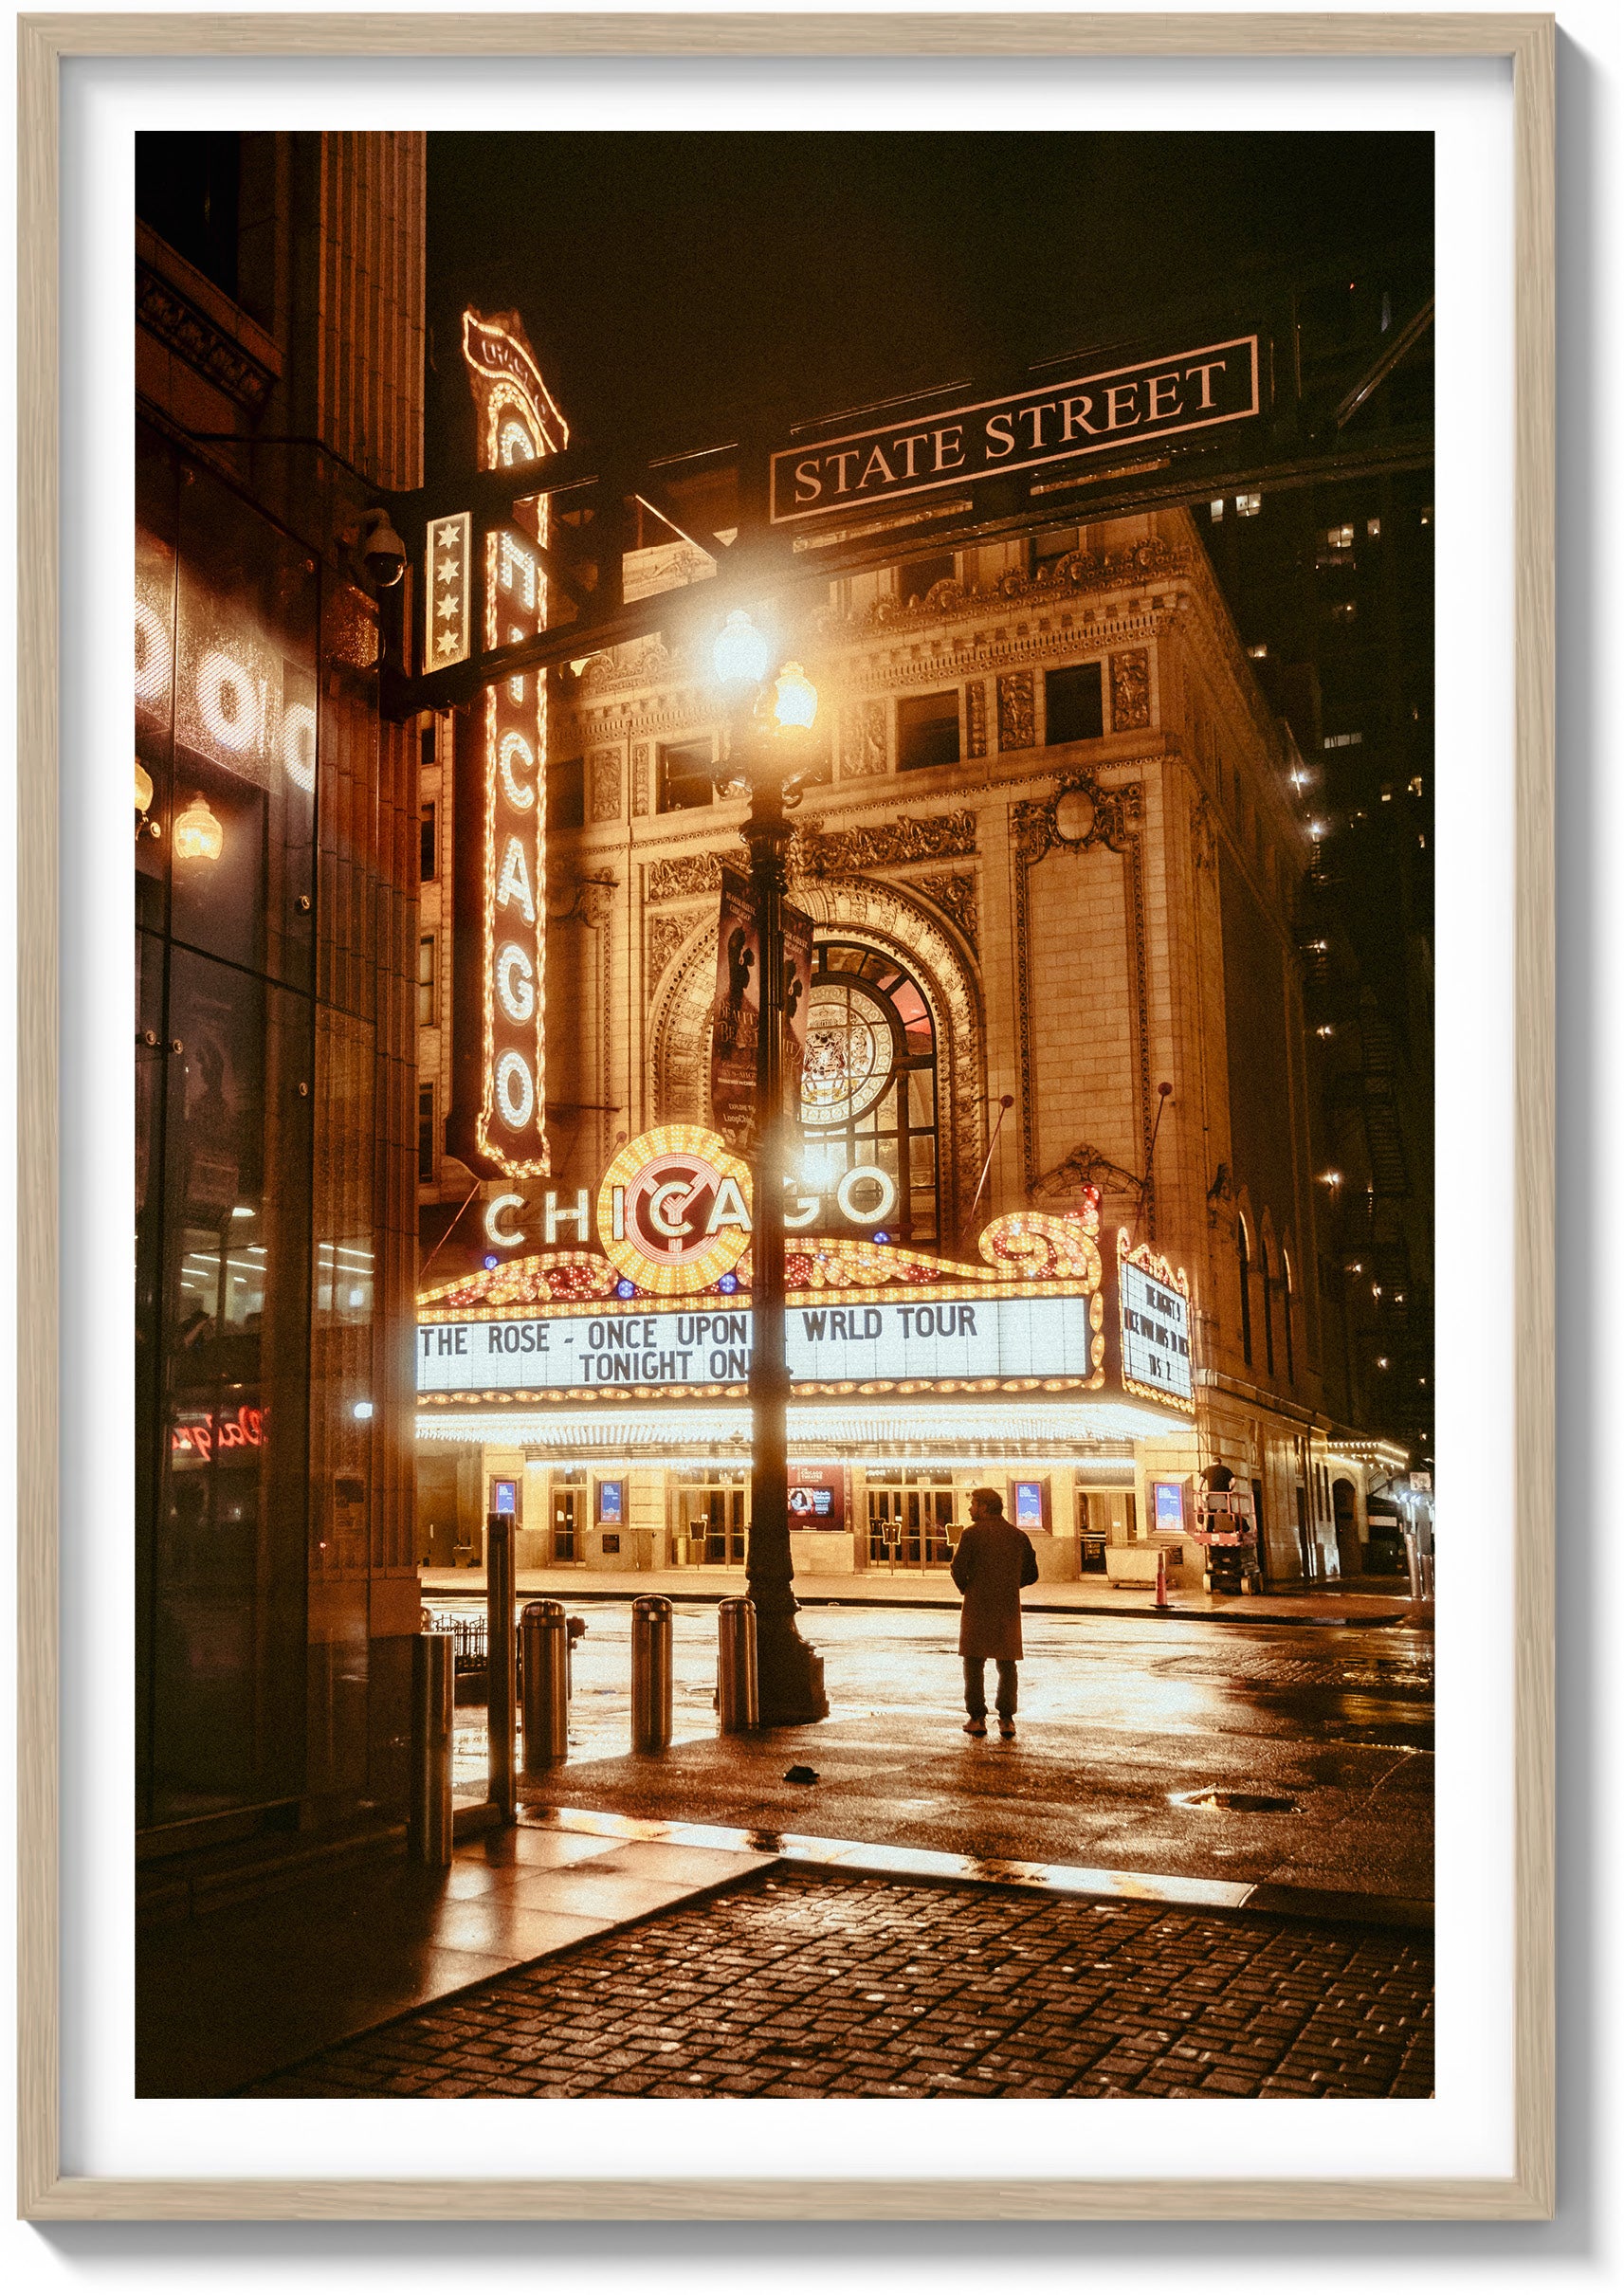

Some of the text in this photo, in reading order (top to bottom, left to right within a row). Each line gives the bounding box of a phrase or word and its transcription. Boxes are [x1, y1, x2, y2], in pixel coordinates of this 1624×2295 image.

[794, 360, 1228, 504] STATE STREET
[484, 1165, 894, 1247] CHICAGO
[420, 1326, 468, 1357] THE
[488, 1323, 551, 1354] ROSE
[588, 1318, 658, 1350] ONCE
[677, 1314, 748, 1346] UPON
[802, 1308, 883, 1342] WRLD
[896, 1305, 978, 1339] TOUR
[578, 1350, 693, 1382] TONIGHT
